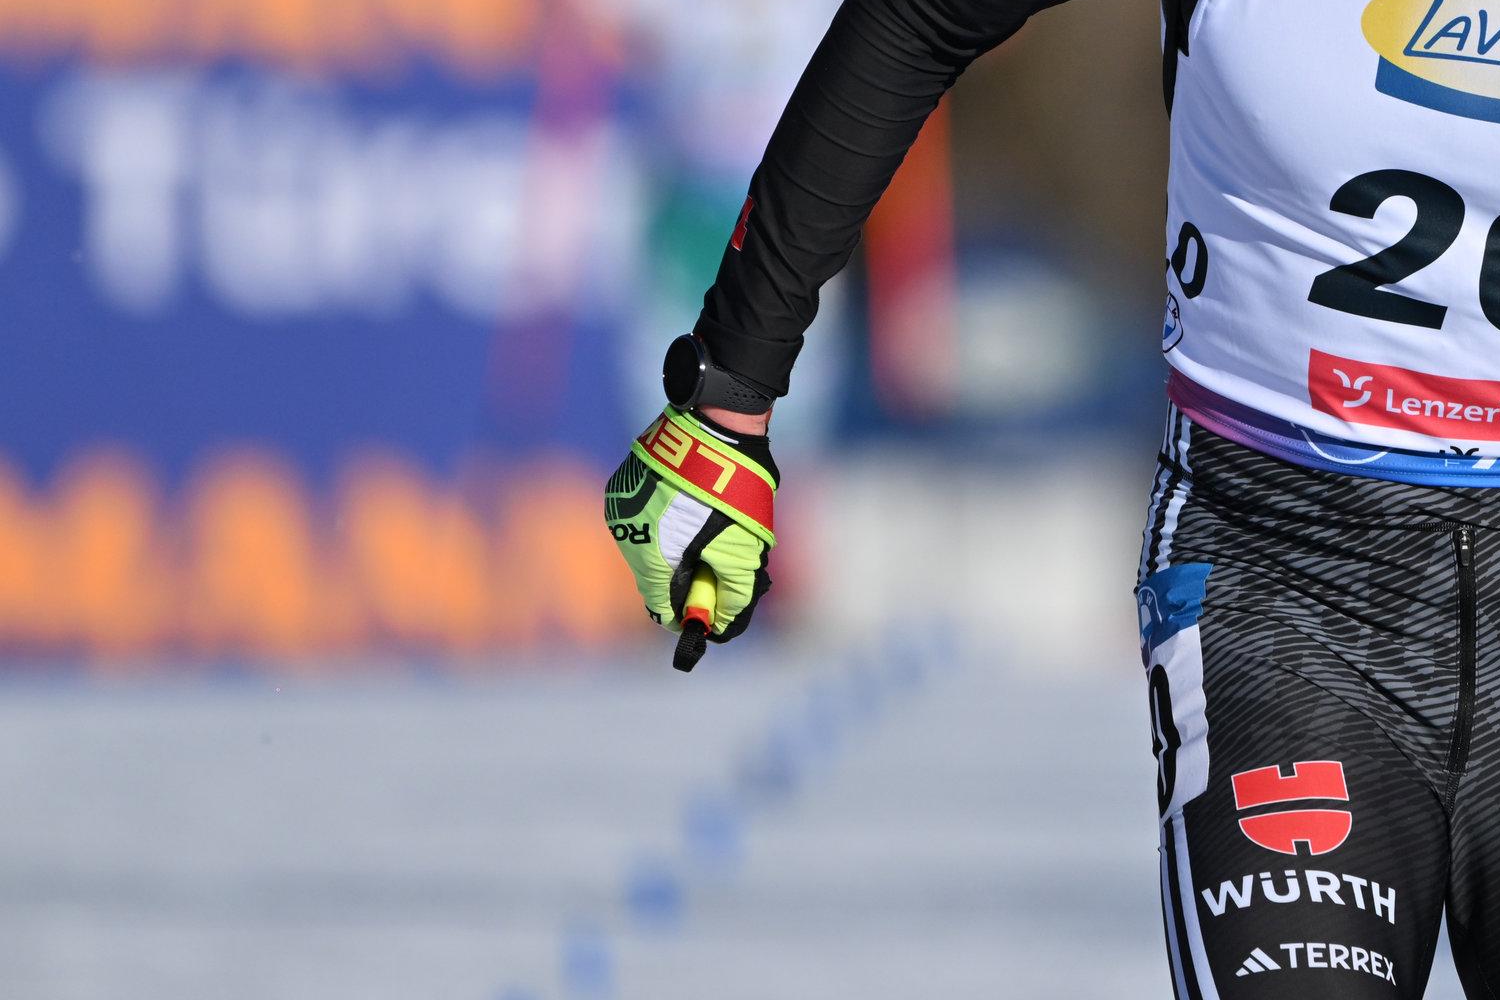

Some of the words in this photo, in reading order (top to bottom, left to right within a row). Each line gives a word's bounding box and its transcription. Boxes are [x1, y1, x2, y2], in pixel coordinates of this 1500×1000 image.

[1166, 221, 1208, 300] 0
[1201, 869, 1396, 925] WÜRTH
[1279, 942, 1397, 987] TERREX
